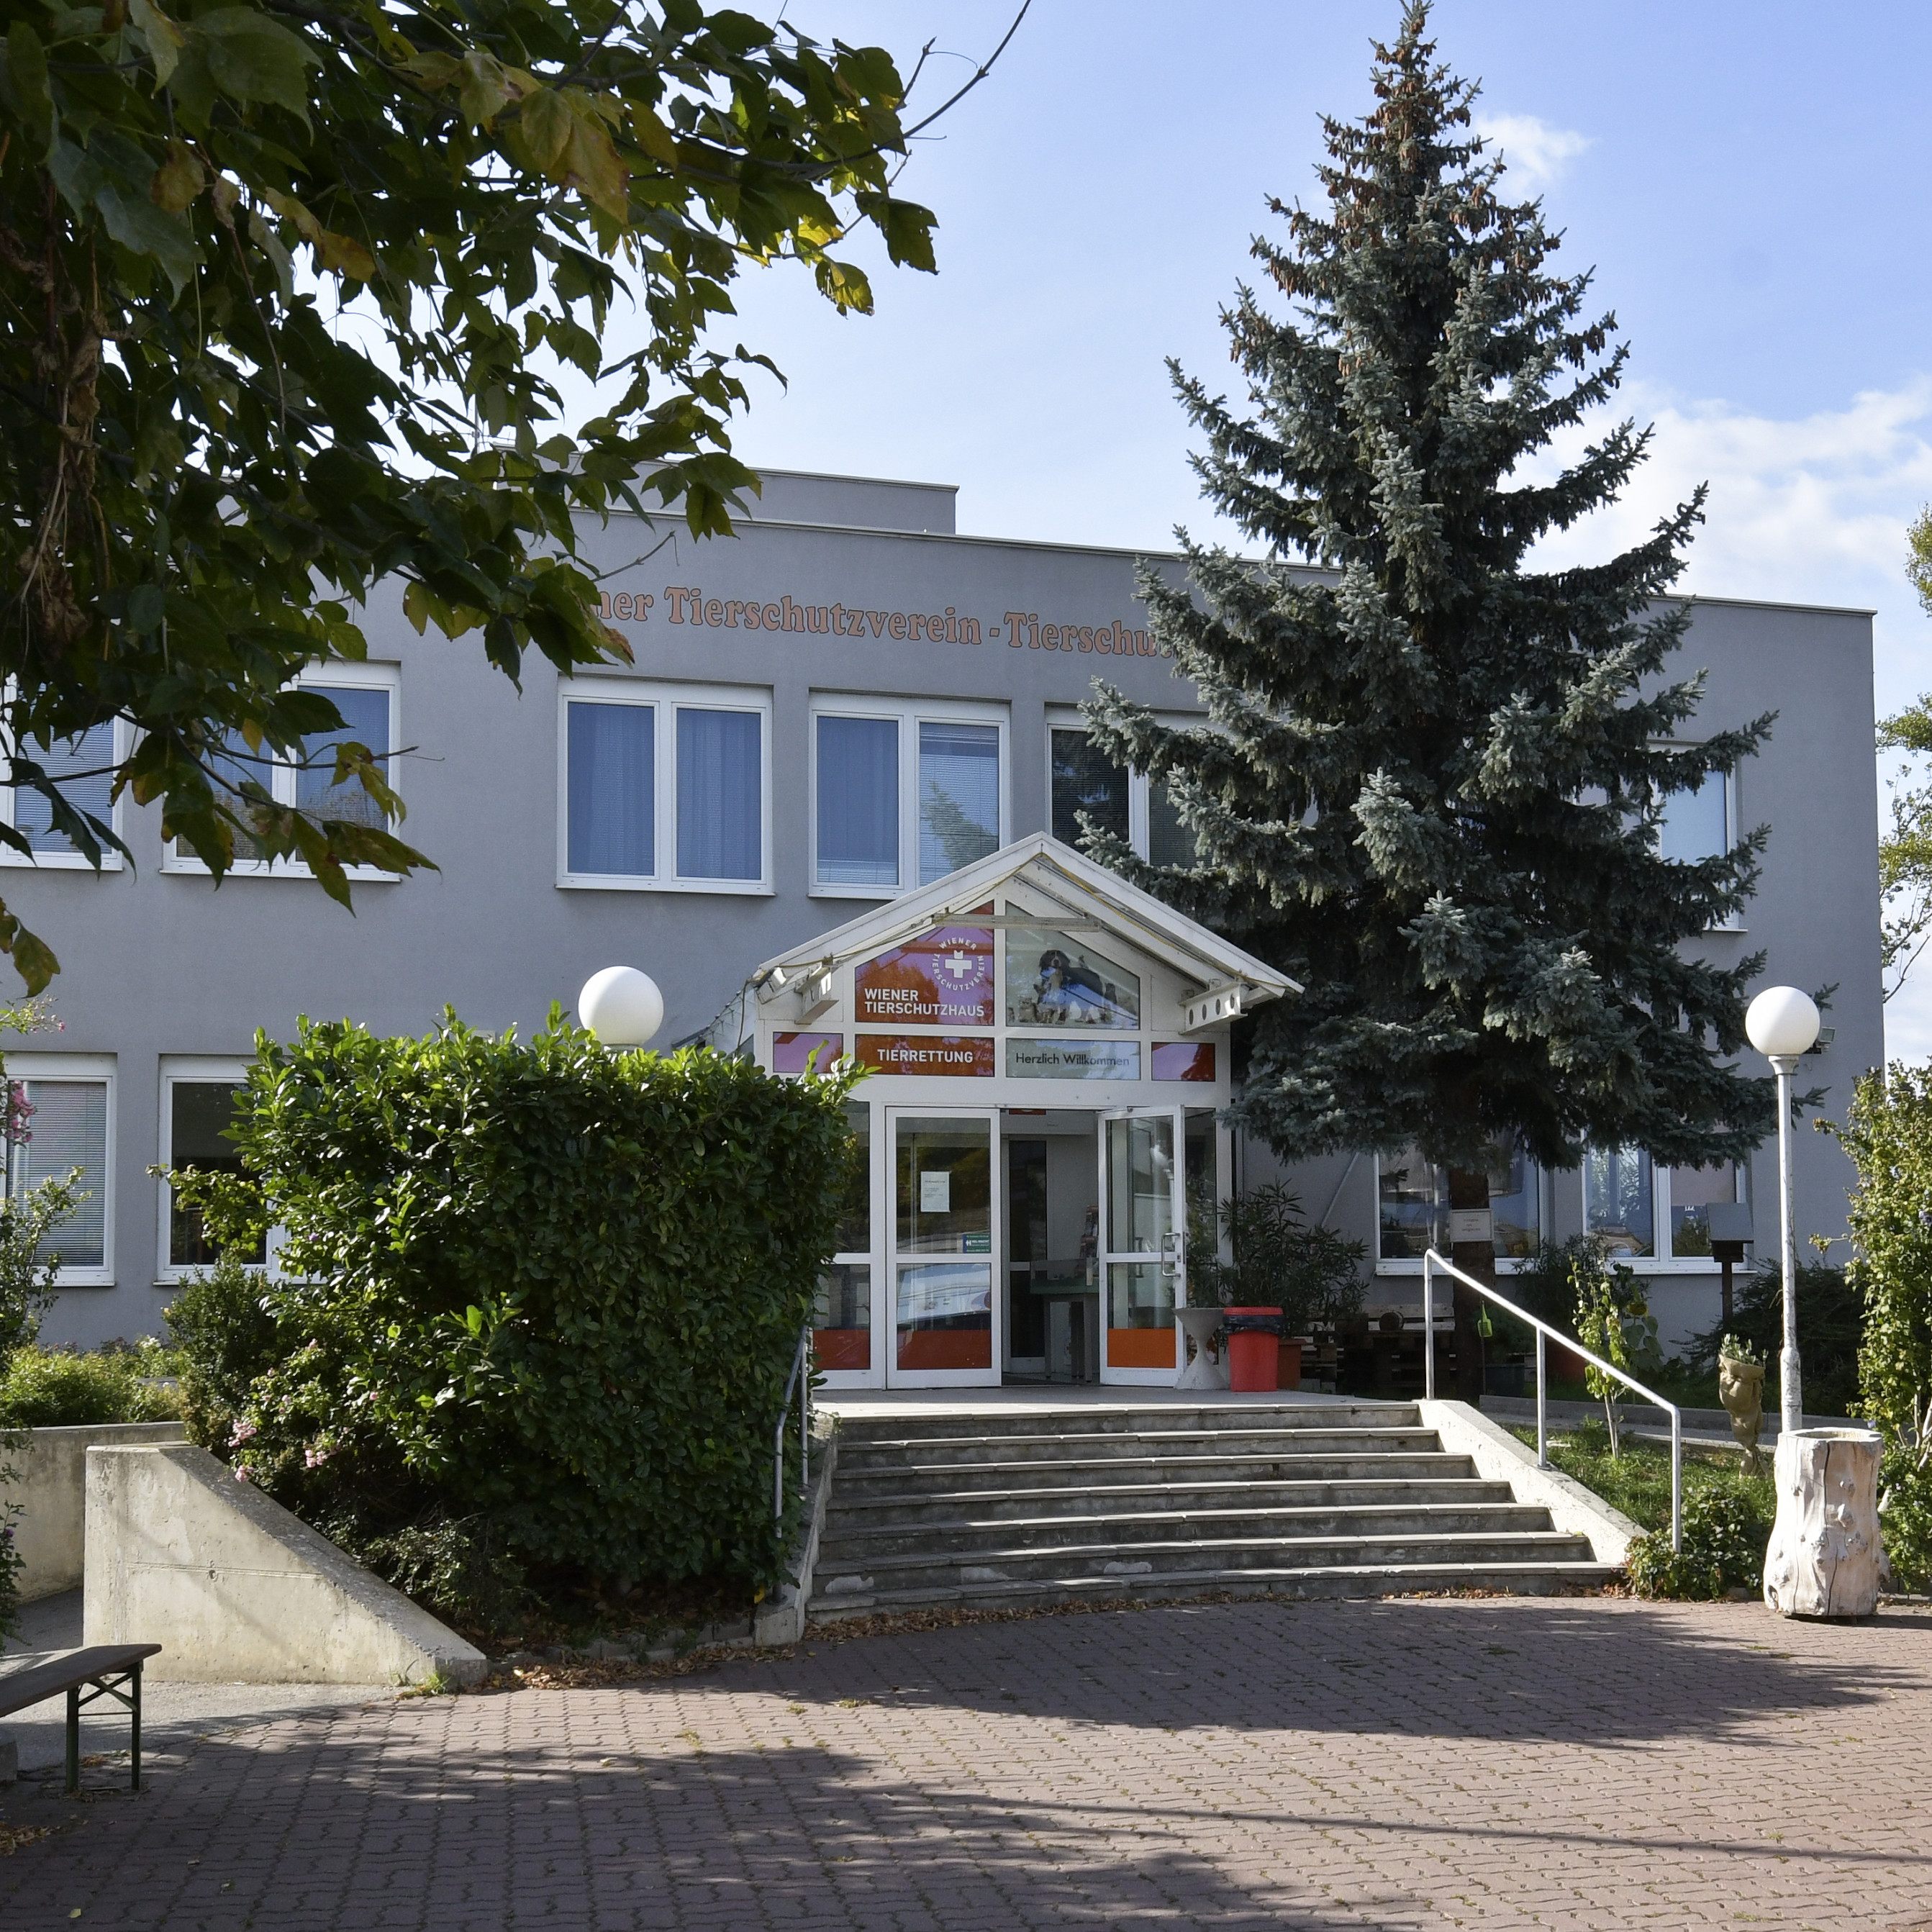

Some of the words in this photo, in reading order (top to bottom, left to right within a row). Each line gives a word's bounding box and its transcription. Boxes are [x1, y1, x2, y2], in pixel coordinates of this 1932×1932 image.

[590, 591, 654, 621] ner
[663, 586, 981, 645] Tierschutzverein
[939, 937, 977, 951] WIENER
[932, 953, 985, 991] TIERSCHUTZVEREIN
[864, 988, 919, 1002] WIENER
[864, 1001, 984, 1017] TIERSCHUTZHAUS
[877, 1048, 973, 1063] TIERRETTUNG
[1015, 1052, 1059, 1064] Herzlich
[1063, 1053, 1130, 1066] Willkommen
